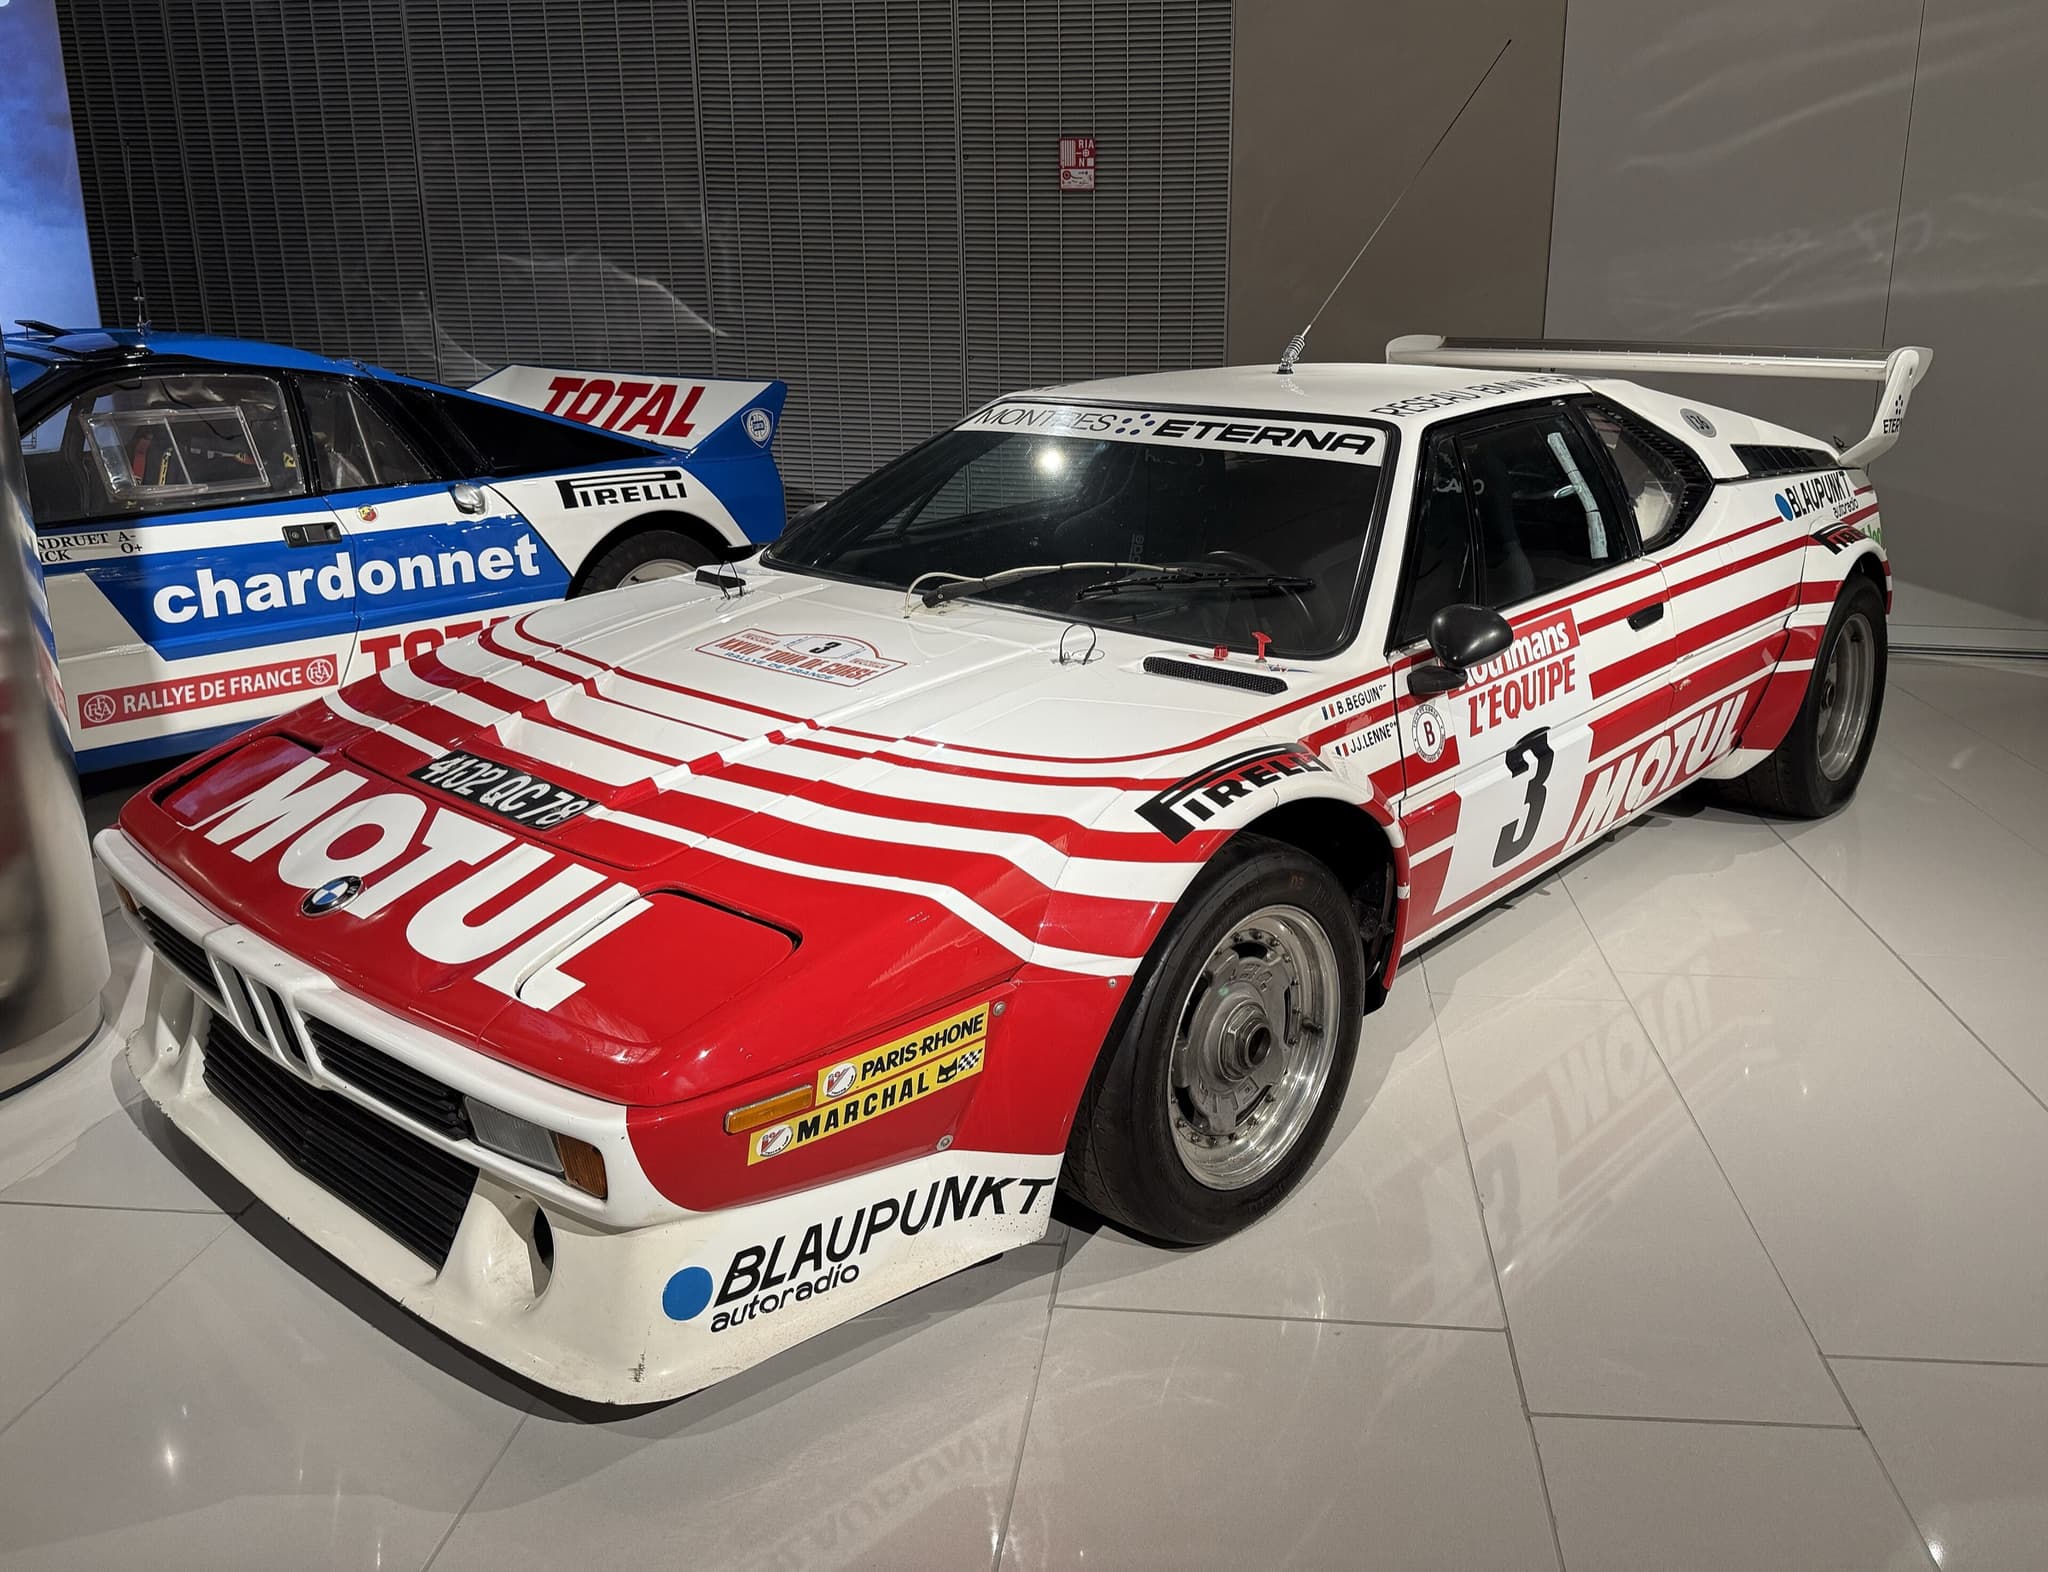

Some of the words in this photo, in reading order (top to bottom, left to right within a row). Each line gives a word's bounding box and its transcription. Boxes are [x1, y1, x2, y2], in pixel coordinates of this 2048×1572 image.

[544, 377, 705, 437] TOTAL
[1152, 419, 1377, 455] ETERNA
[555, 470, 687, 509] PIRELLI
[1784, 470, 1851, 519] BLAUPUNKT
[38, 532, 109, 552] NDRUET
[40, 549, 73, 564] ICK
[153, 534, 540, 624] chardonnet
[809, 641, 842, 654] 3
[123, 685, 196, 713] RALLYE
[200, 680, 226, 700] DE
[230, 667, 302, 695] FRANCE
[1424, 721, 1435, 747] B
[1134, 743, 1332, 844] PIRELLI
[1492, 726, 1554, 868] 3
[1562, 690, 1749, 851] MOTUL
[176, 756, 654, 1012] MOTUL
[797, 1072, 929, 1144] MARCHAL
[713, 1176, 1056, 1308] BLAUPUNKT
[710, 1263, 860, 1334] autoradio
